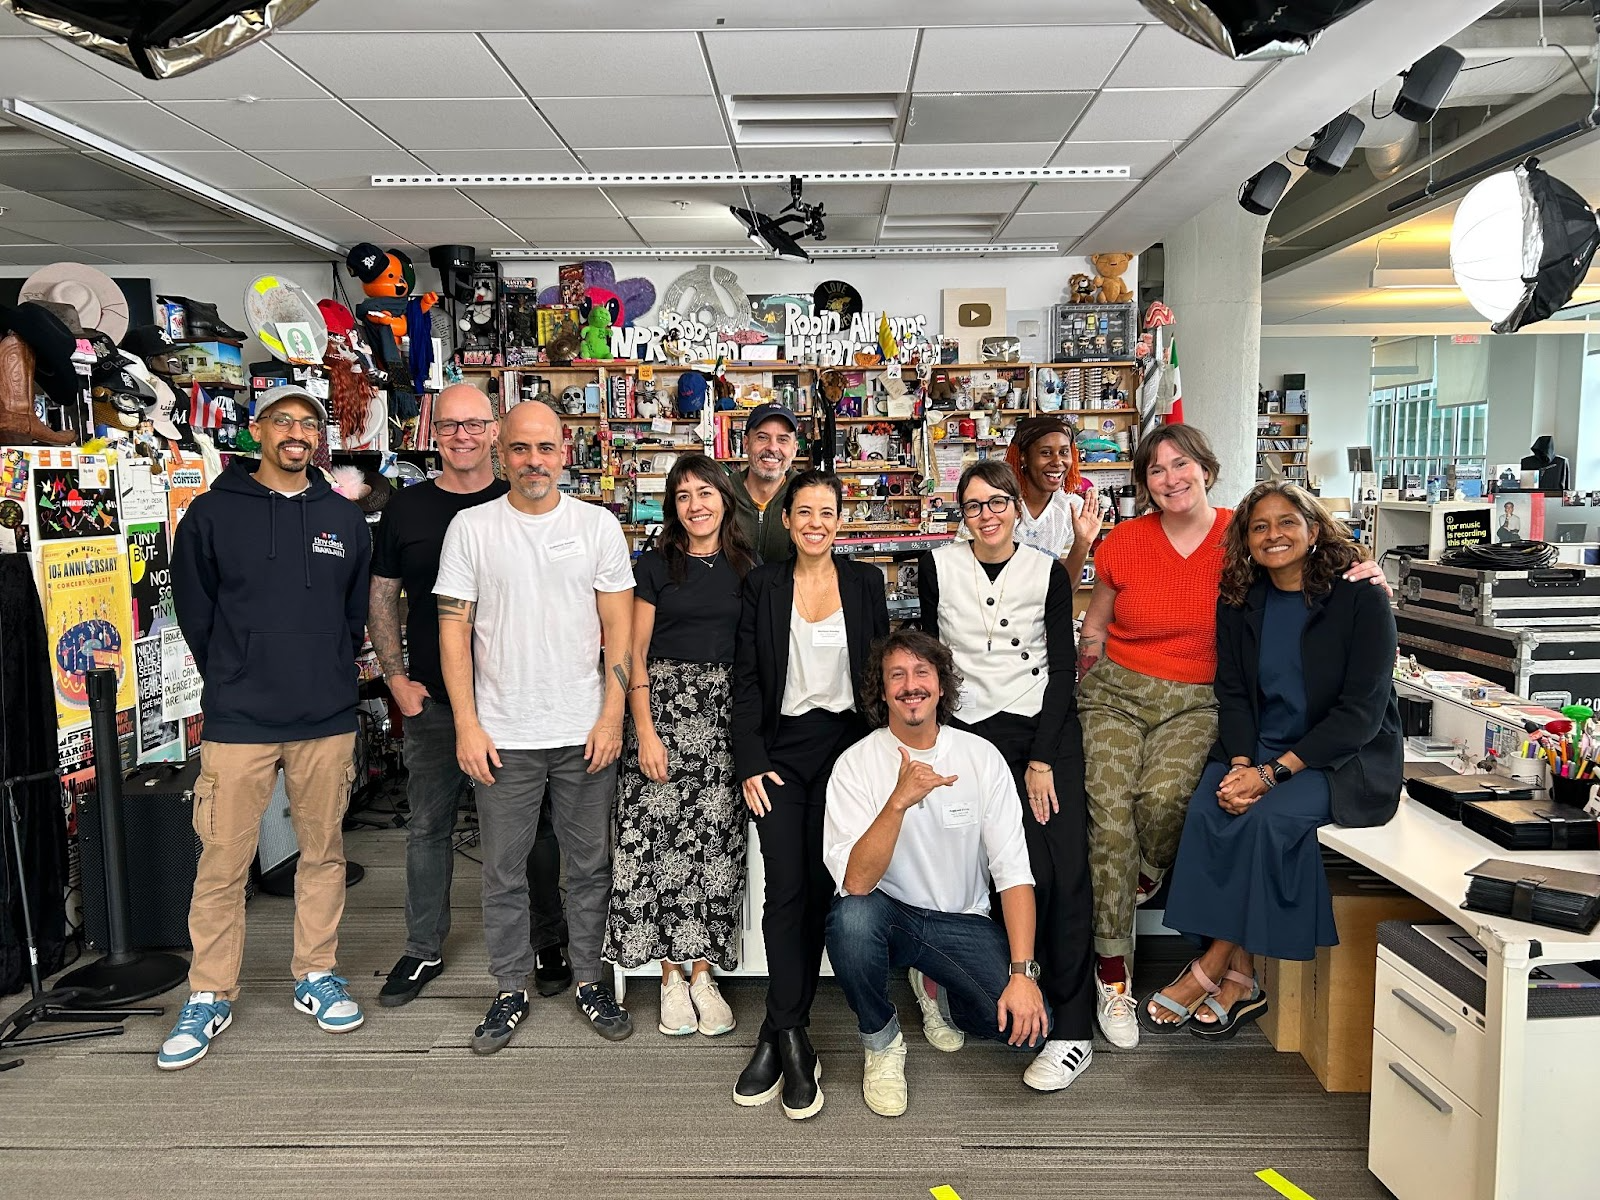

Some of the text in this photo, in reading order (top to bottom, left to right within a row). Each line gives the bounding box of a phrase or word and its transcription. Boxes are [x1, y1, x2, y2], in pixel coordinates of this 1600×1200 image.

[823, 282, 848, 294] LOVE
[668, 312, 707, 343] Bob
[784, 303, 840, 336] Robin
[849, 311, 876, 343] All
[876, 314, 927, 352] ongs
[611, 326, 667, 362] NPR
[678, 331, 740, 364] Boilen
[784, 334, 853, 366] Hilton
[254, 378, 287, 388] npr
[172, 476, 201, 484] CONTEST
[1447, 521, 1480, 531] npr music
[1447, 529, 1487, 539] is recording
[132, 529, 158, 546] TINY
[314, 536, 344, 549] tiny desk
[1447, 537, 1480, 547] this show
[67, 546, 101, 558] NPR MUSIC
[134, 545, 159, 563] BUT-
[64, 557, 118, 577] ANNIVERSARY
[57, 580, 86, 589] CONCERT
[150, 569, 172, 586] NOT
[159, 586, 173, 601] SO
[150, 602, 173, 618] TINY
[137, 643, 154, 657] NICK
[139, 661, 161, 678] SEEDS
[141, 684, 162, 701] YEAHS
[165, 677, 191, 696] PLEASE?
[165, 695, 180, 708] ARE
[60, 730, 91, 747] NPR
